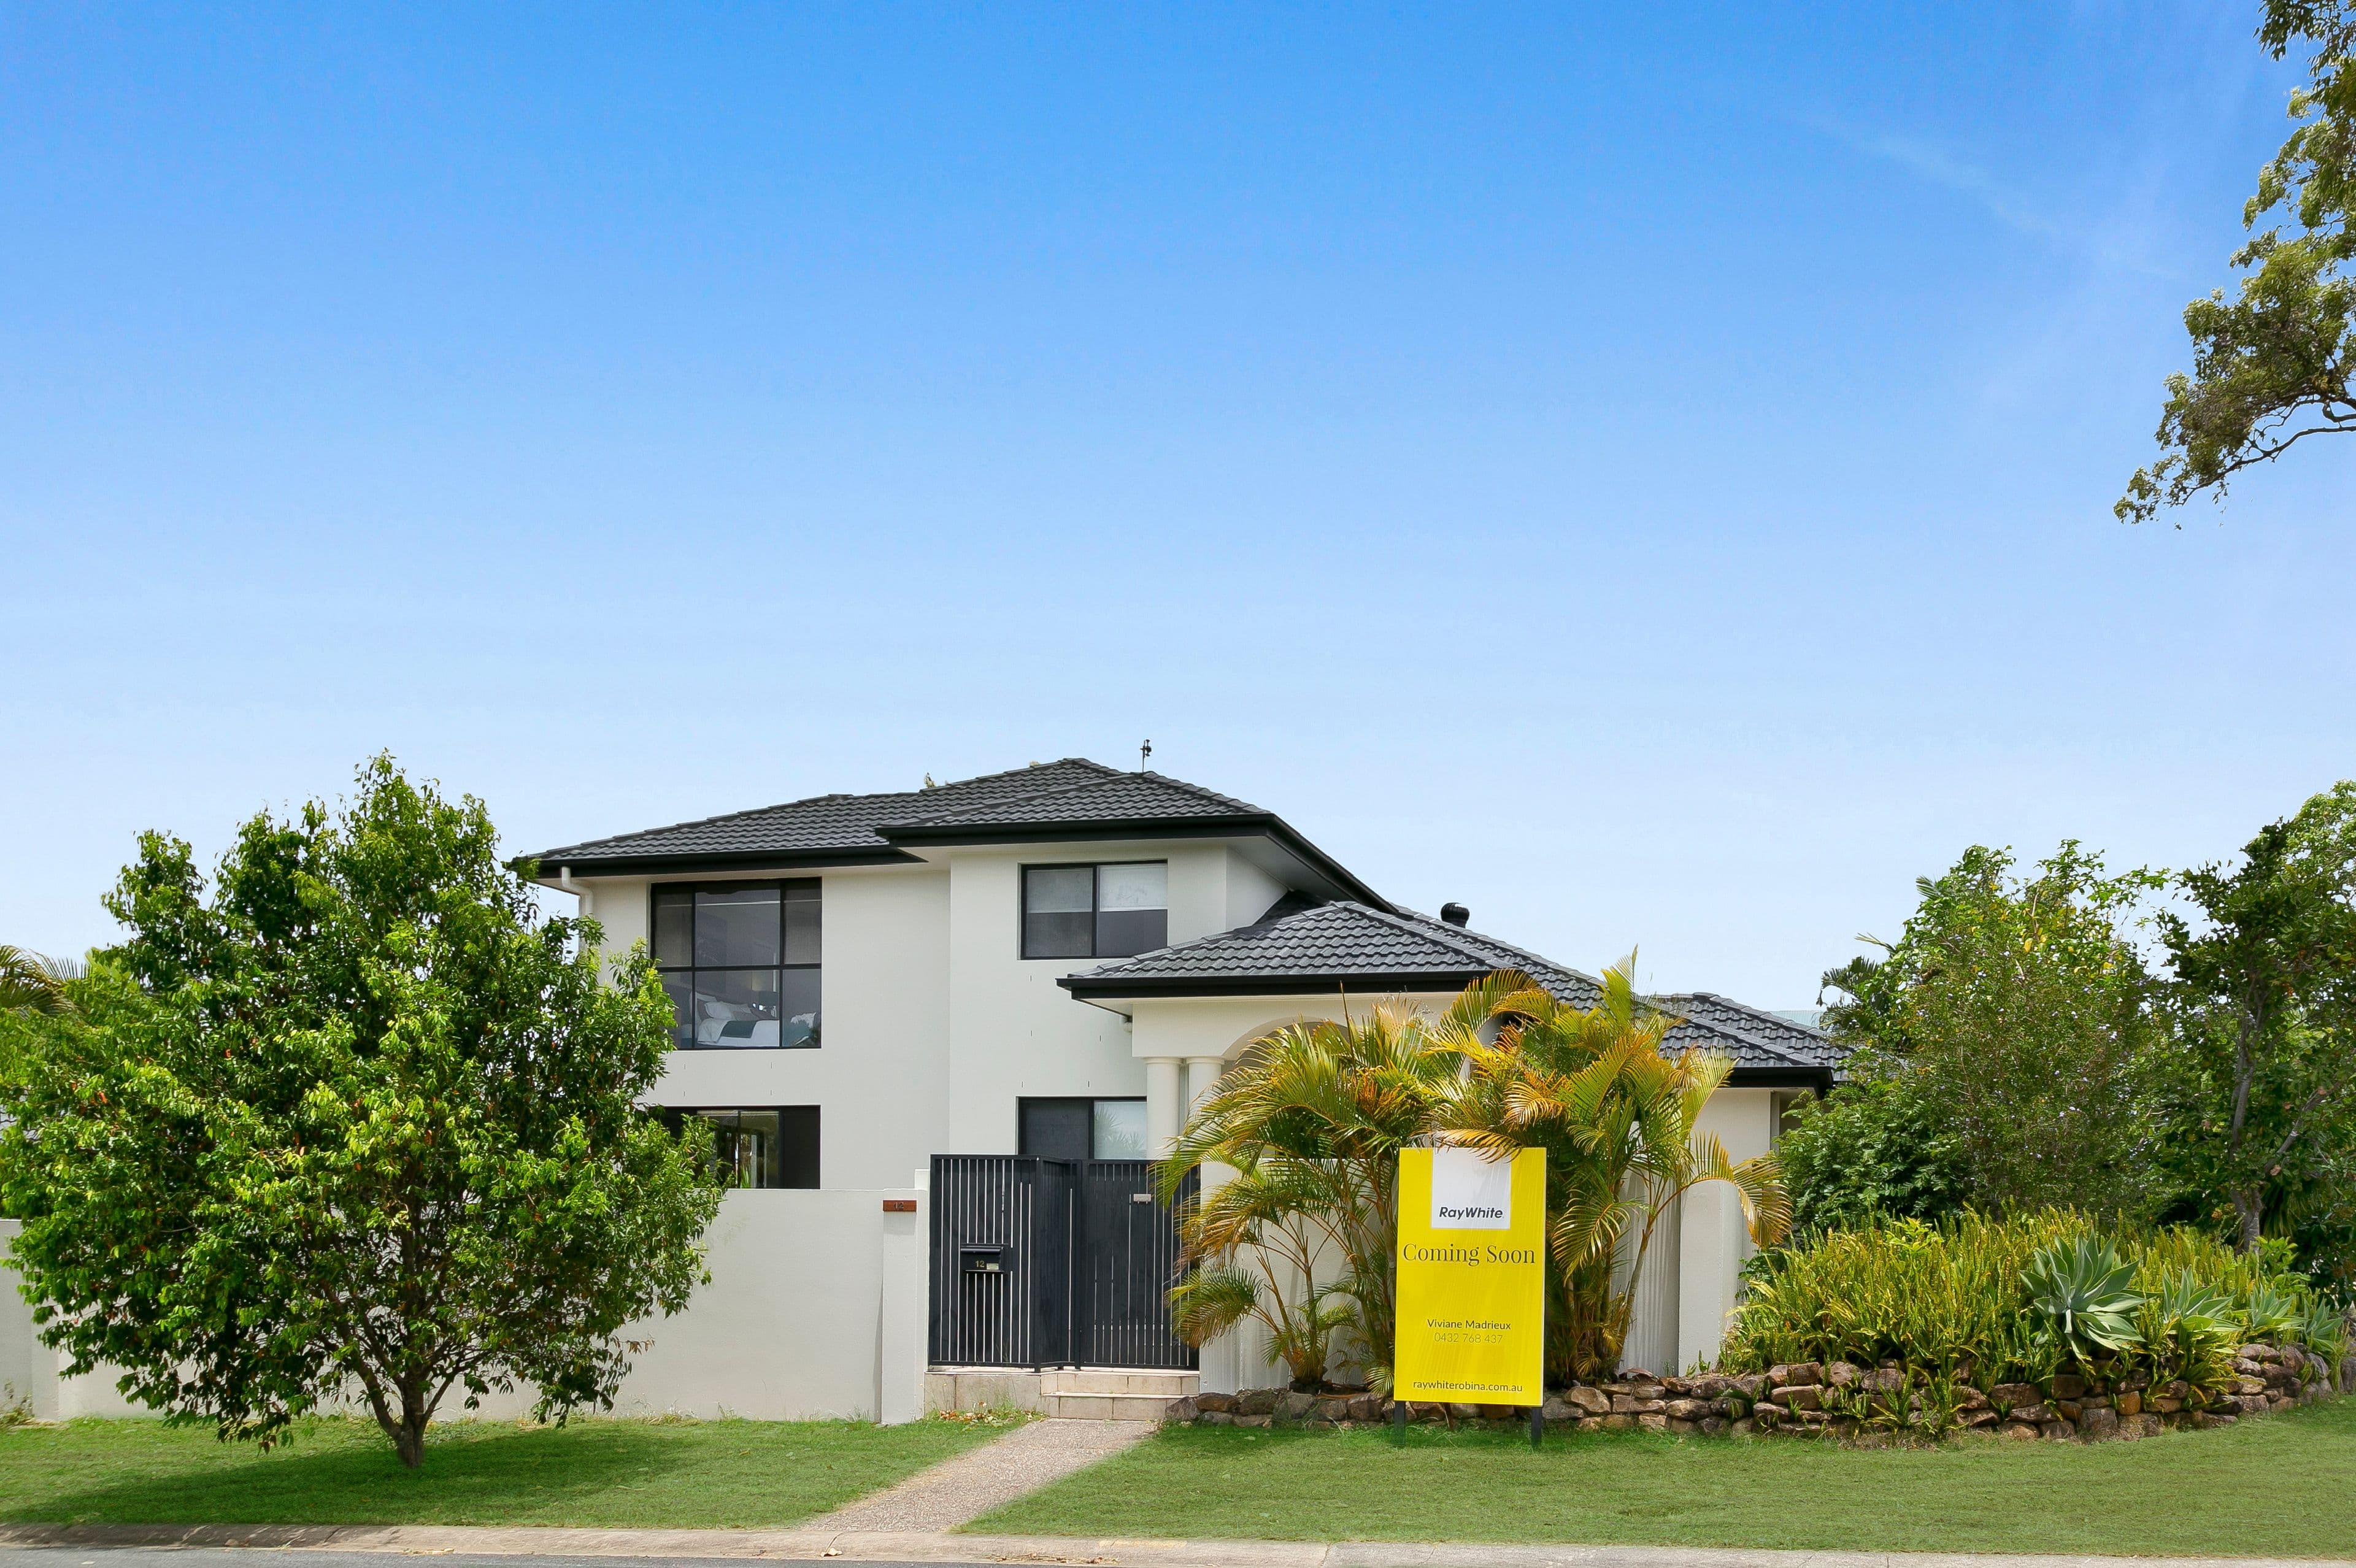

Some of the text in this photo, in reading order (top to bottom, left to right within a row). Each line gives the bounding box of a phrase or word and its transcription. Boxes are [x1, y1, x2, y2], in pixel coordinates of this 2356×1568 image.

[1439, 1207, 1503, 1220] RayWhite
[1403, 1243, 1536, 1267] Coming Soon
[1427, 1319, 1511, 1330] Viviane Madrieux
[1434, 1332, 1503, 1344] 0432 768 437
[1413, 1380, 1523, 1392] raywhiterobina.com.au
